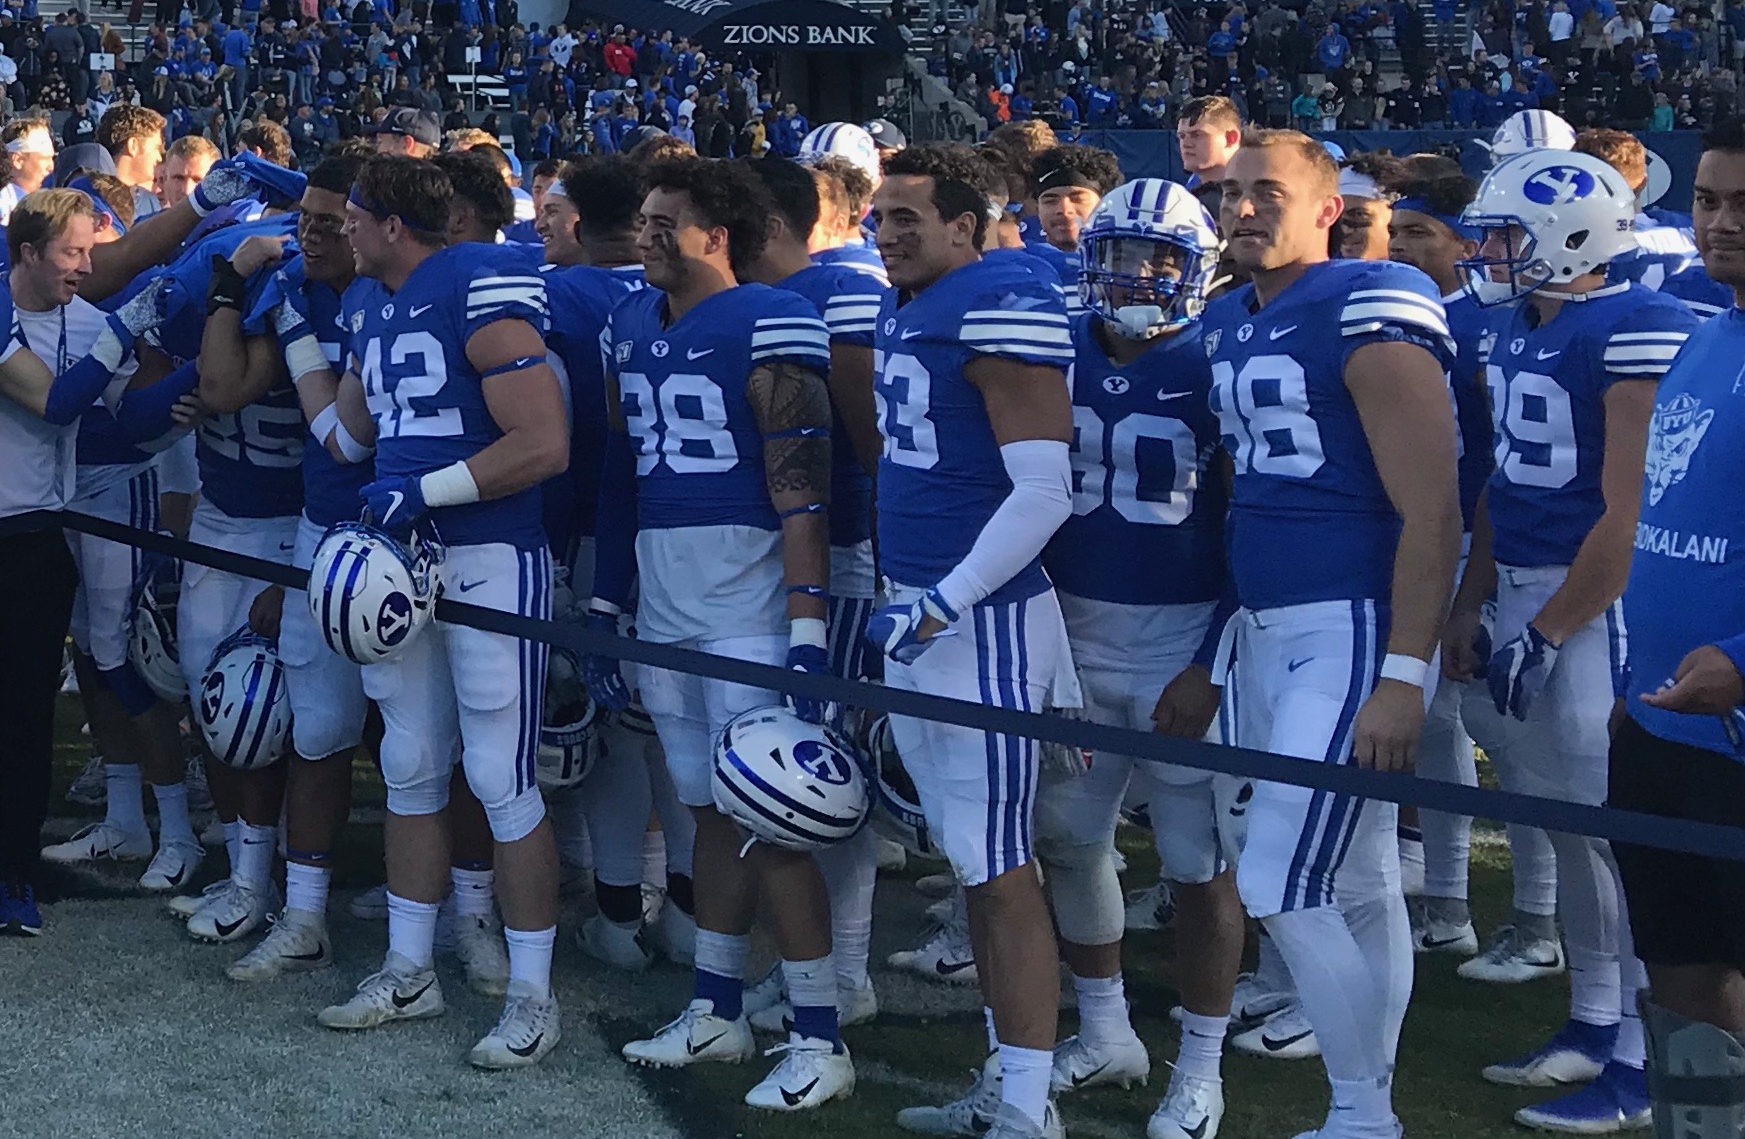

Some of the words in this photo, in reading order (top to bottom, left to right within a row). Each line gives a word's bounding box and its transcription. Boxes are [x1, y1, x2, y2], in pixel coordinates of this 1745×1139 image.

[723, 24, 800, 45] ZIONS
[806, 24, 876, 45] BANK
[361, 330, 464, 440] 42
